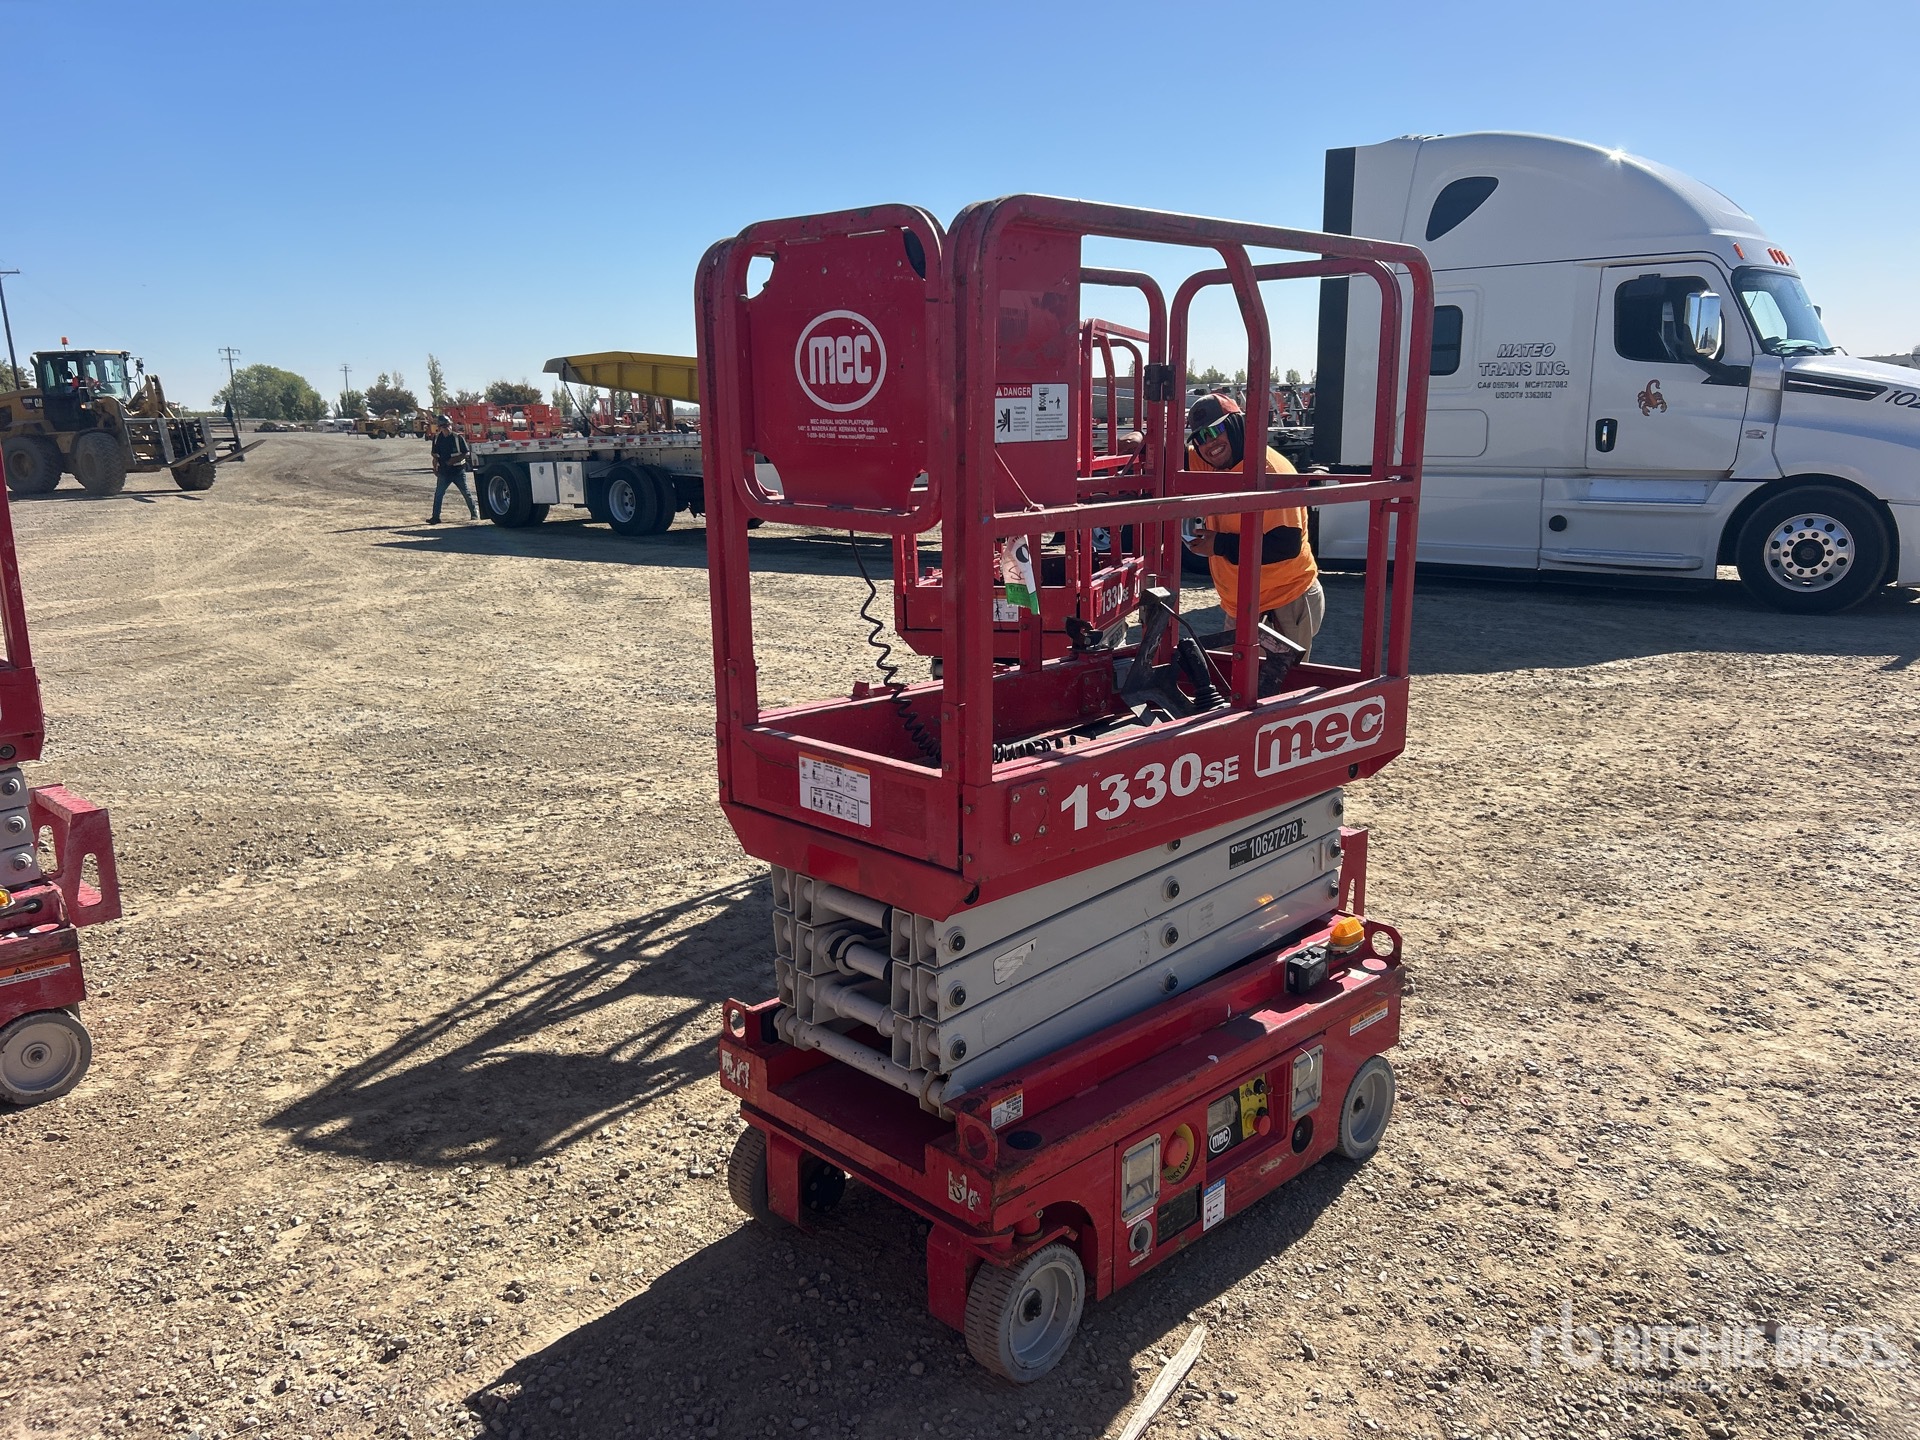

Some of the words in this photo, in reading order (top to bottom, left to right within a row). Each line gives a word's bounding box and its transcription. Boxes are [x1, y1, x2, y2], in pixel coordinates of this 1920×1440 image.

[1497, 343, 1556, 358] MATEO
[809, 335, 872, 385] mec
[1479, 362, 1532, 376] TRANS
[1535, 361, 1570, 376] INC.
[1003, 387, 1031, 397] DANGER
[1496, 391, 1523, 399] USDOT#
[1256, 702, 1383, 774] mec
[1250, 822, 1299, 858] 10627279
[25, 961, 54, 971] WARNING
[1212, 1129, 1229, 1149] mec
